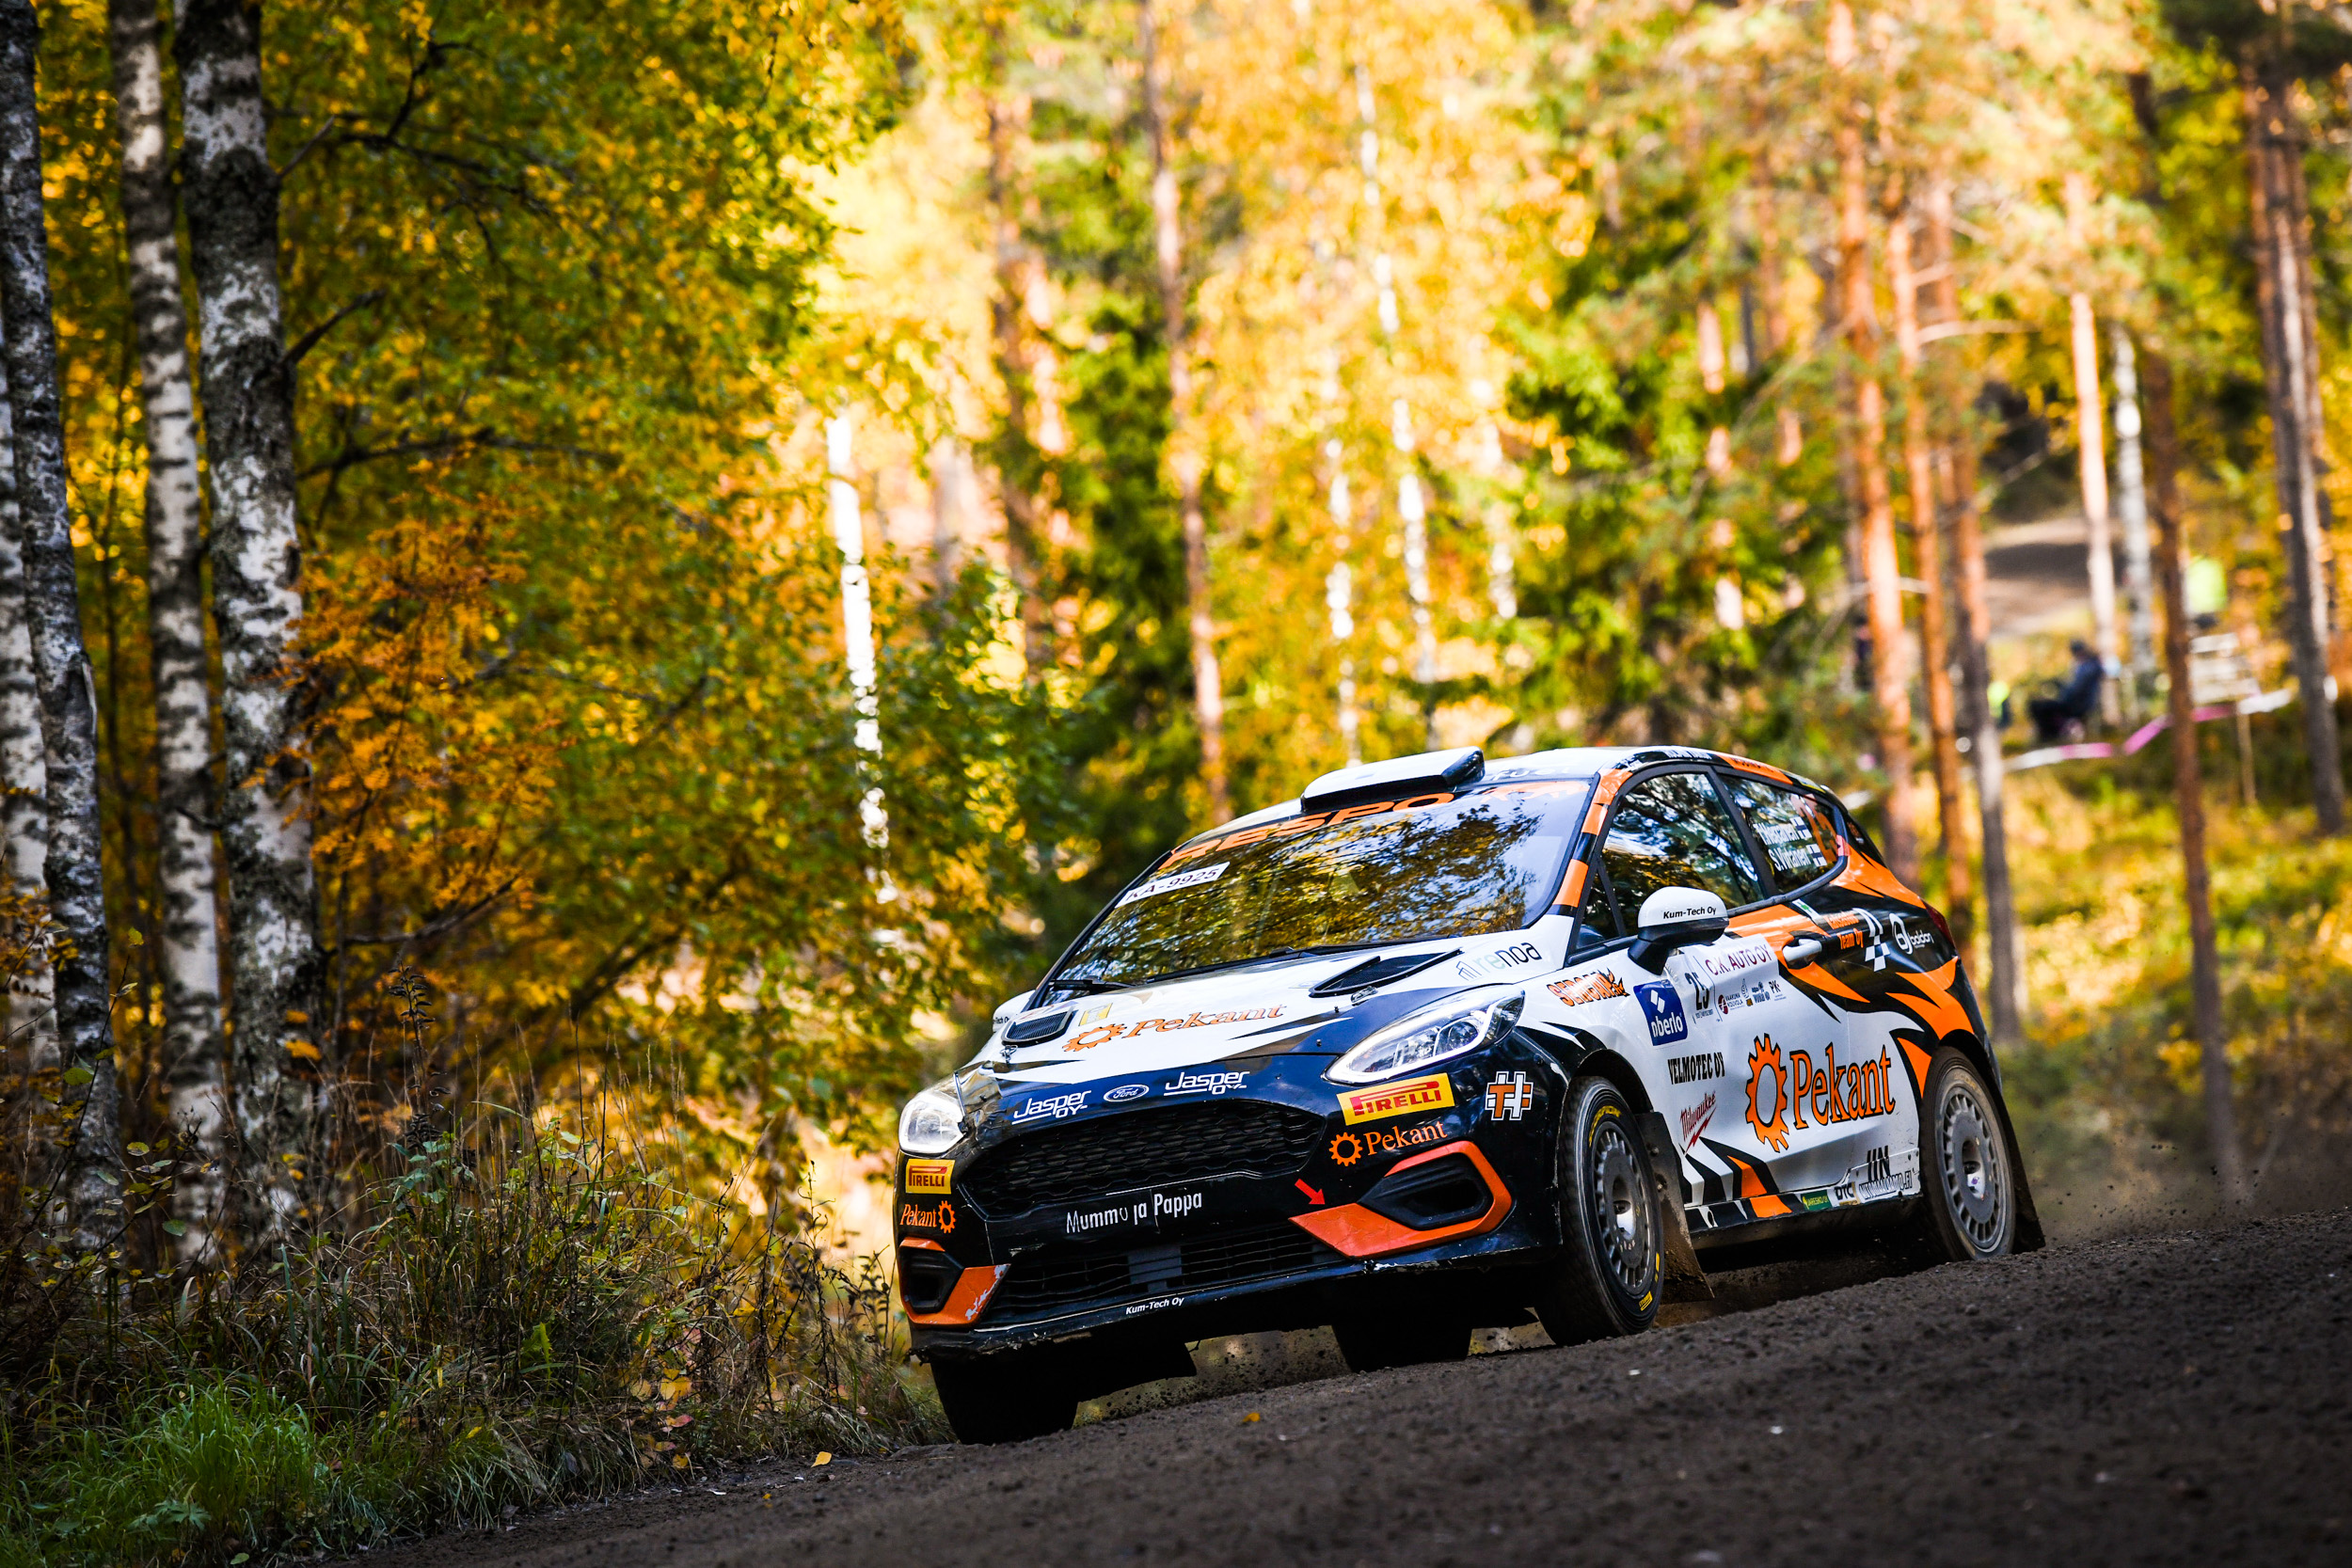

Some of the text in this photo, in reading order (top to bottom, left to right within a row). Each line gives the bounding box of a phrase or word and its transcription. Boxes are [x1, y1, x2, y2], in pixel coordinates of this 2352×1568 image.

[1158, 792, 1455, 870] RESPO
[1125, 867, 1220, 903] KA-9925
[1662, 906, 1717, 920] Kum-Tech Oy
[1476, 942, 1543, 974] renoa
[1728, 948, 1758, 973] AUTO
[1756, 943, 1772, 963] OY
[1684, 971, 1710, 1011] 25
[1121, 1003, 1287, 1039] Pekant
[1164, 1070, 1250, 1093] Jasper
[1668, 1052, 1725, 1085] VELMOTEC OY
[1349, 1080, 1442, 1117] PIRELLI
[1788, 1041, 1896, 1131] Pekant
[1012, 1090, 1092, 1119] Jasper
[1056, 1104, 1089, 1119] OY
[1679, 1090, 1717, 1142] Milwaukee
[1363, 1120, 1449, 1156] Pekant
[908, 1164, 948, 1188] PIRELLI
[899, 1203, 937, 1228] Pekant
[1153, 1192, 1202, 1219] Pappa
[1125, 1295, 1184, 1315] Kum-Tech Oy
